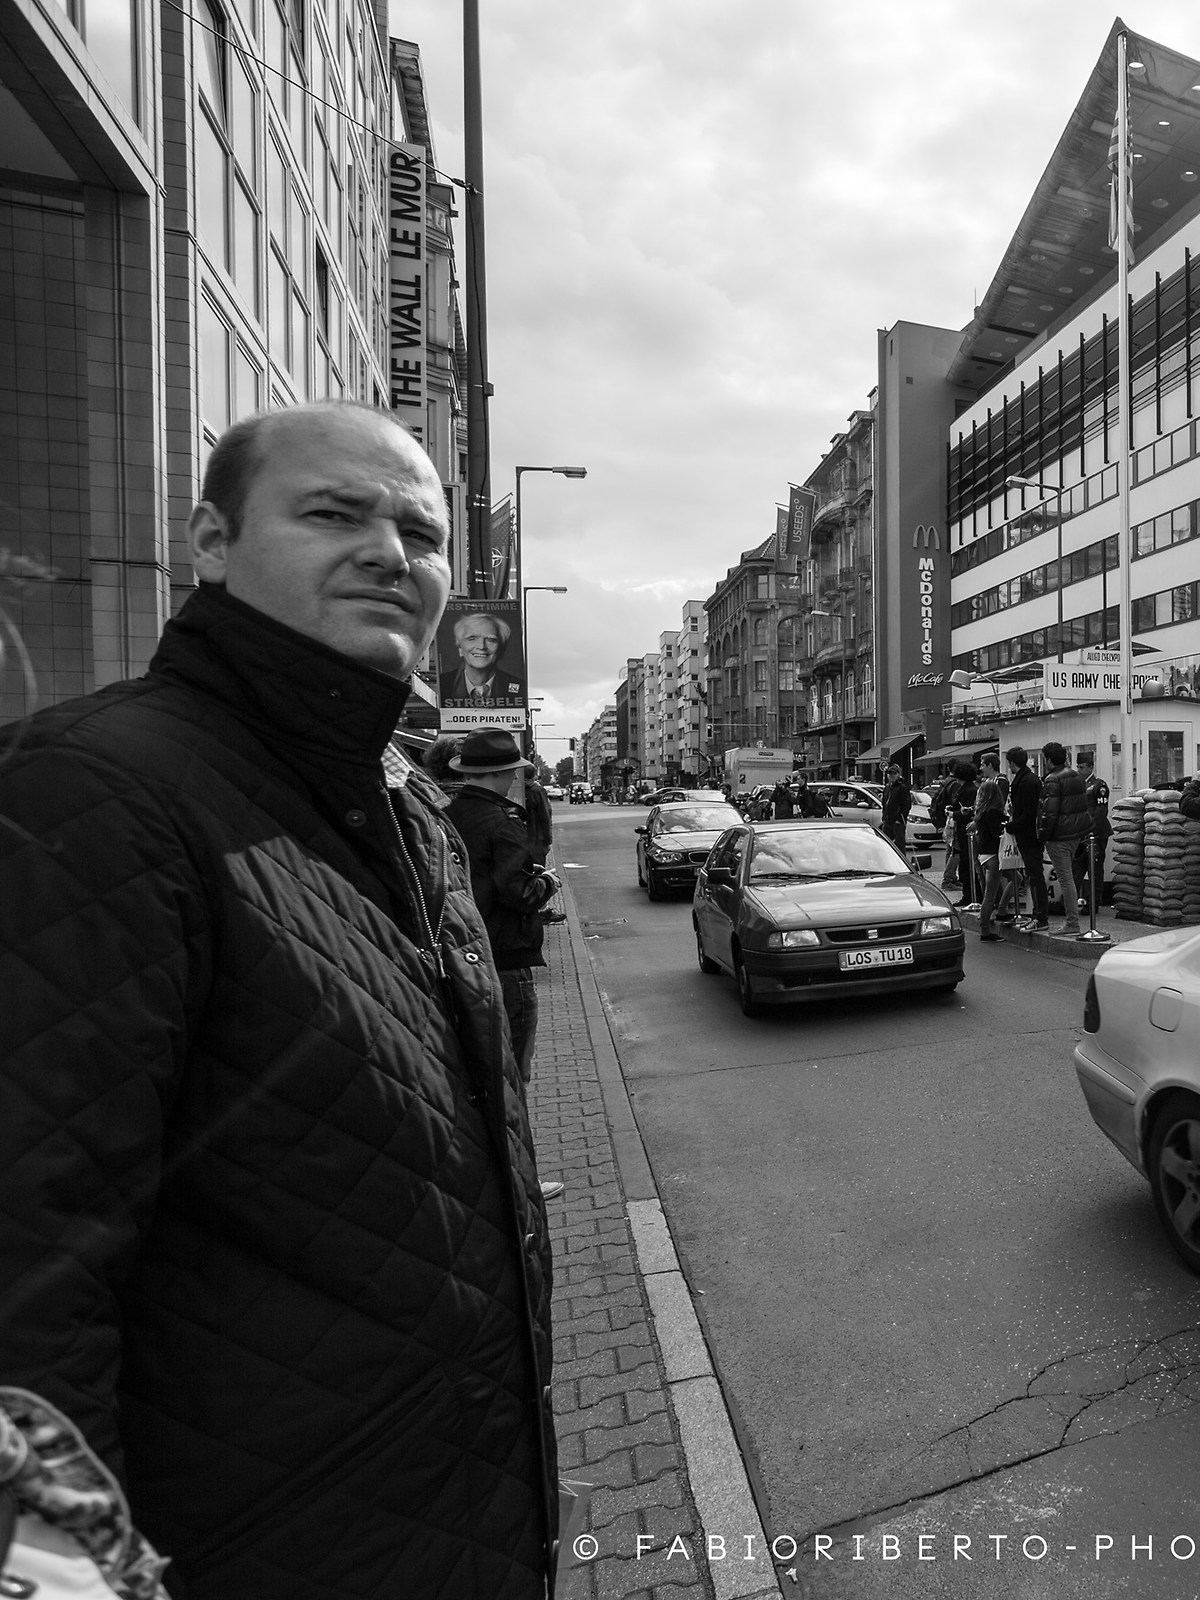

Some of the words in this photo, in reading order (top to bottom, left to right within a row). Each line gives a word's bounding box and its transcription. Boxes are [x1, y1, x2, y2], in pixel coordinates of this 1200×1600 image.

[390, 227, 422, 261] LE
[390, 274, 422, 350] WALL
[390, 357, 422, 409] THE
[446, 602, 518, 611] RSTSTIMME
[1052, 672, 1067, 688] US
[1072, 673, 1100, 689] ARMY
[480, 715, 521, 723] PIRATEN!
[847, 951, 872, 966] LOS
